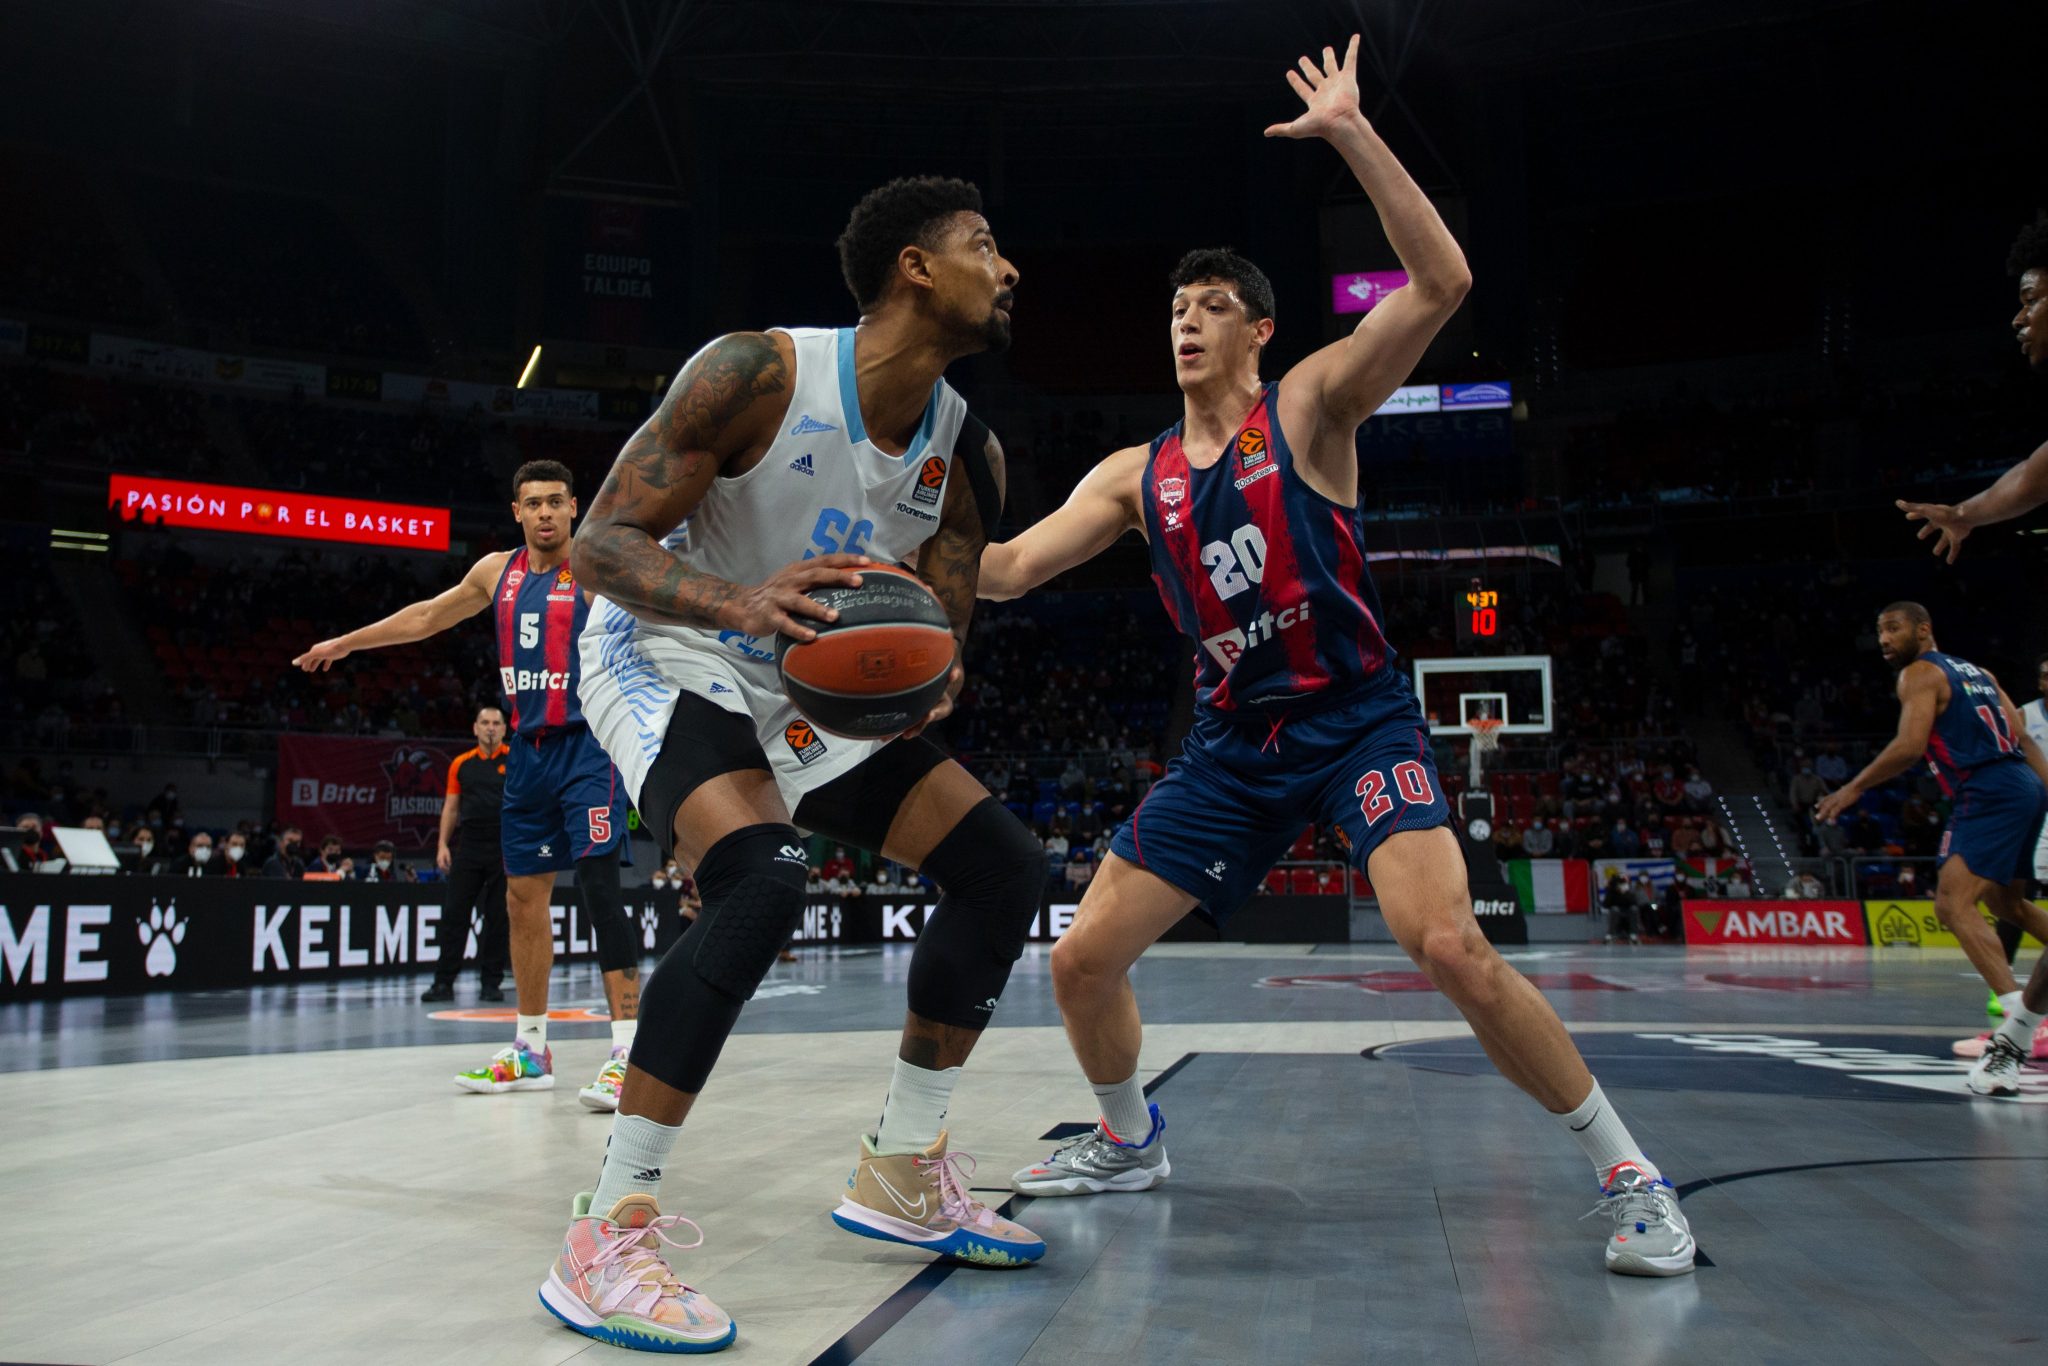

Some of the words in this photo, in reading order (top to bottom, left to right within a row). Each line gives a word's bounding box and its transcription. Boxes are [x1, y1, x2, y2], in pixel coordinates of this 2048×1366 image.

[584, 253, 652, 276] EQUIPO
[581, 275, 653, 299] TALDEA
[789, 462, 815, 476] adidas
[126, 490, 226, 517] PASIÓN
[304, 508, 330, 527] EL
[344, 512, 434, 537] BASKET
[895, 502, 938, 523] 10oneteam
[1200, 524, 1267, 601] 20
[520, 613, 539, 648] 5
[1472, 609, 1496, 636] 10
[518, 669, 570, 690] Bitci
[321, 783, 377, 804] Bitci
[1355, 760, 1434, 827] 20
[589, 806, 611, 843] 5
[1474, 900, 1515, 915] Bitci
[252, 904, 441, 972] KELME
[1723, 911, 1853, 939] AMBAR
